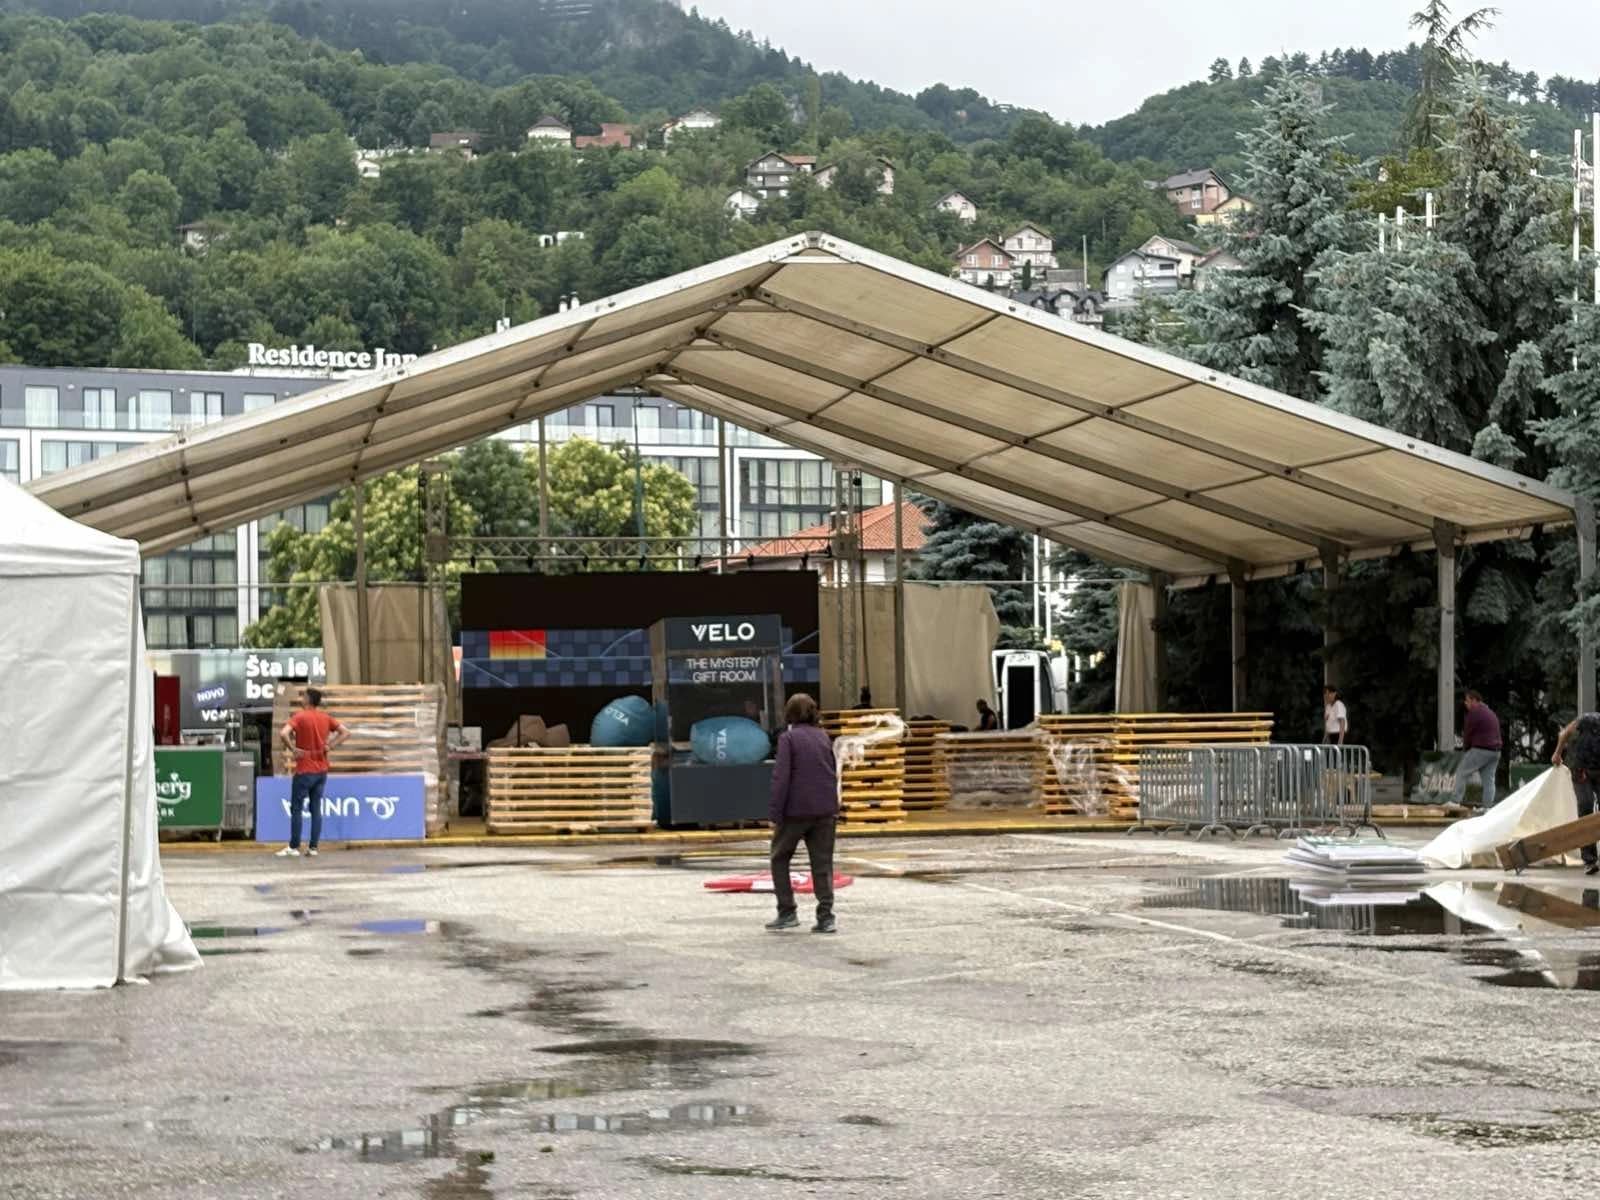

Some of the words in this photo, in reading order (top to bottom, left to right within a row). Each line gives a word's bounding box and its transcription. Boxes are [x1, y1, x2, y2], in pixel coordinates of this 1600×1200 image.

[248, 343, 371, 368] Residence
[691, 622, 755, 641] VELO
[246, 654, 283, 677] Šta
[686, 658, 708, 669] THE
[710, 656, 760, 668] MYSTERY
[692, 671, 718, 683] GIFT
[720, 670, 756, 682] ROOM
[197, 688, 225, 702] NOVO
[716, 727, 728, 760] VELO
